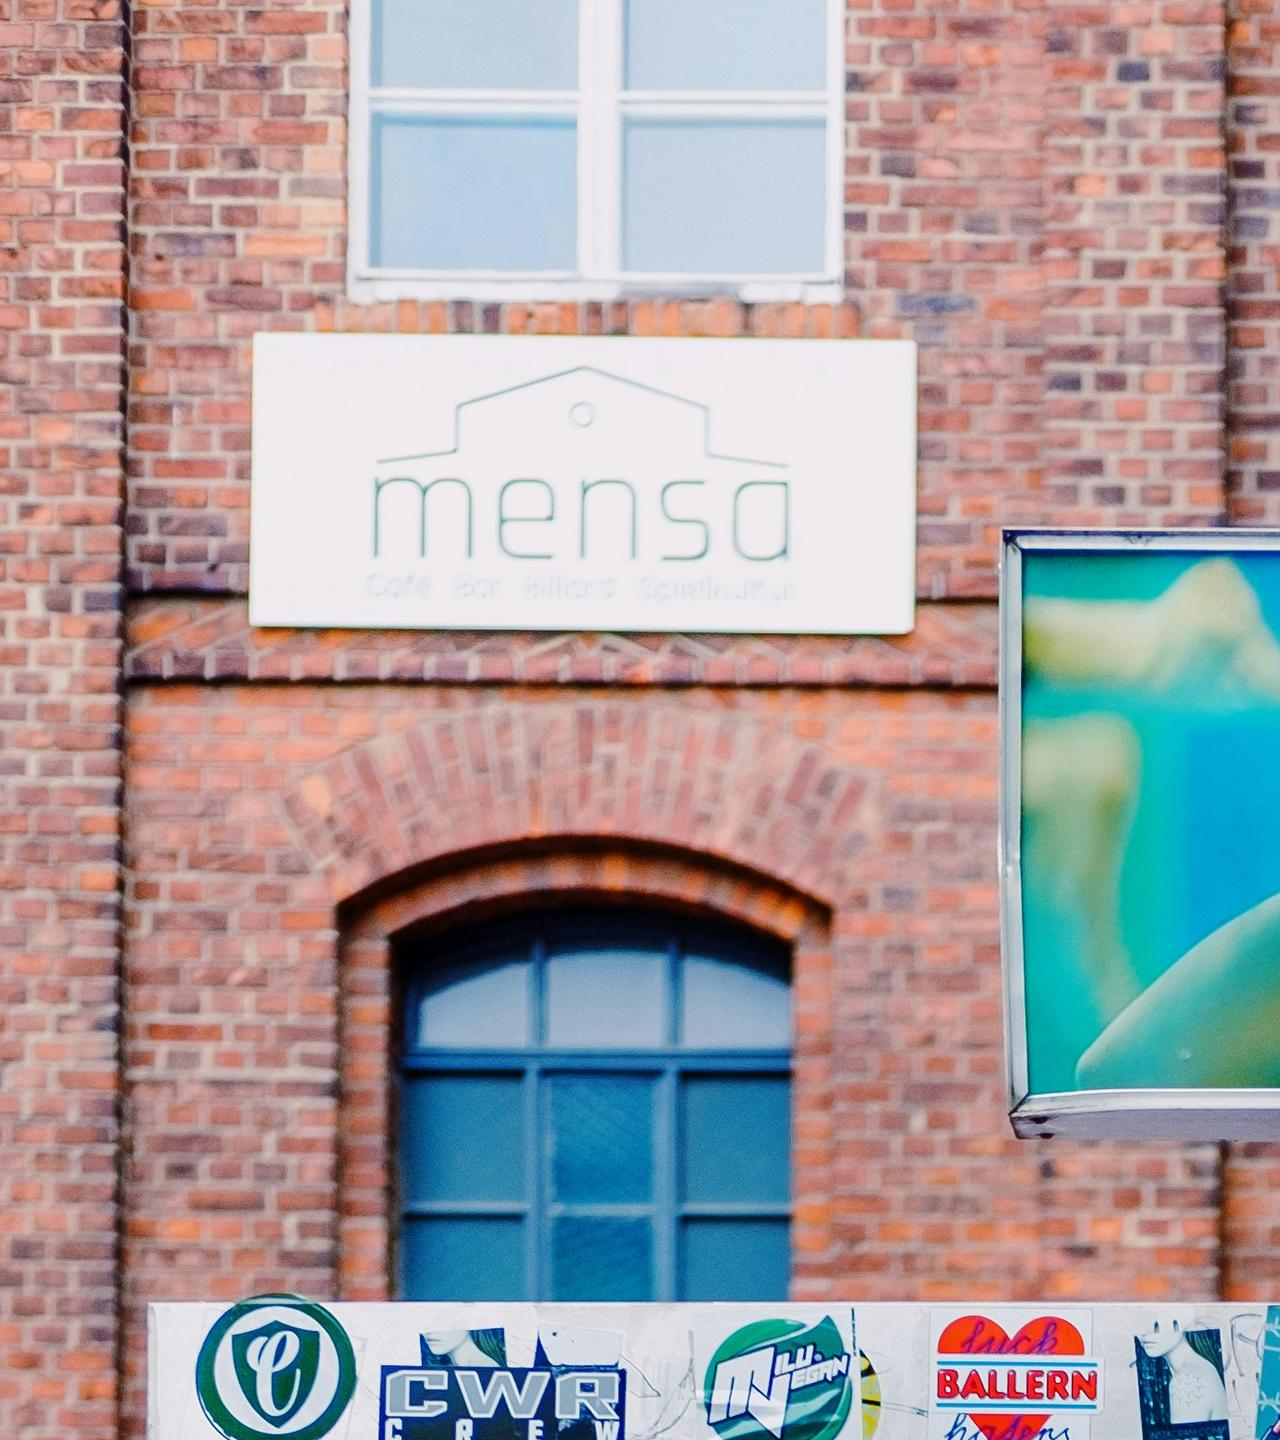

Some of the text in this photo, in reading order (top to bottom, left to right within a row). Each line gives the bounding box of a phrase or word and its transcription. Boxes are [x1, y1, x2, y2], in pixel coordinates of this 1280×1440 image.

[372, 476, 790, 561] mensa
[385, 1370, 621, 1418] CWR
[937, 1369, 1098, 1401] BALLERN
